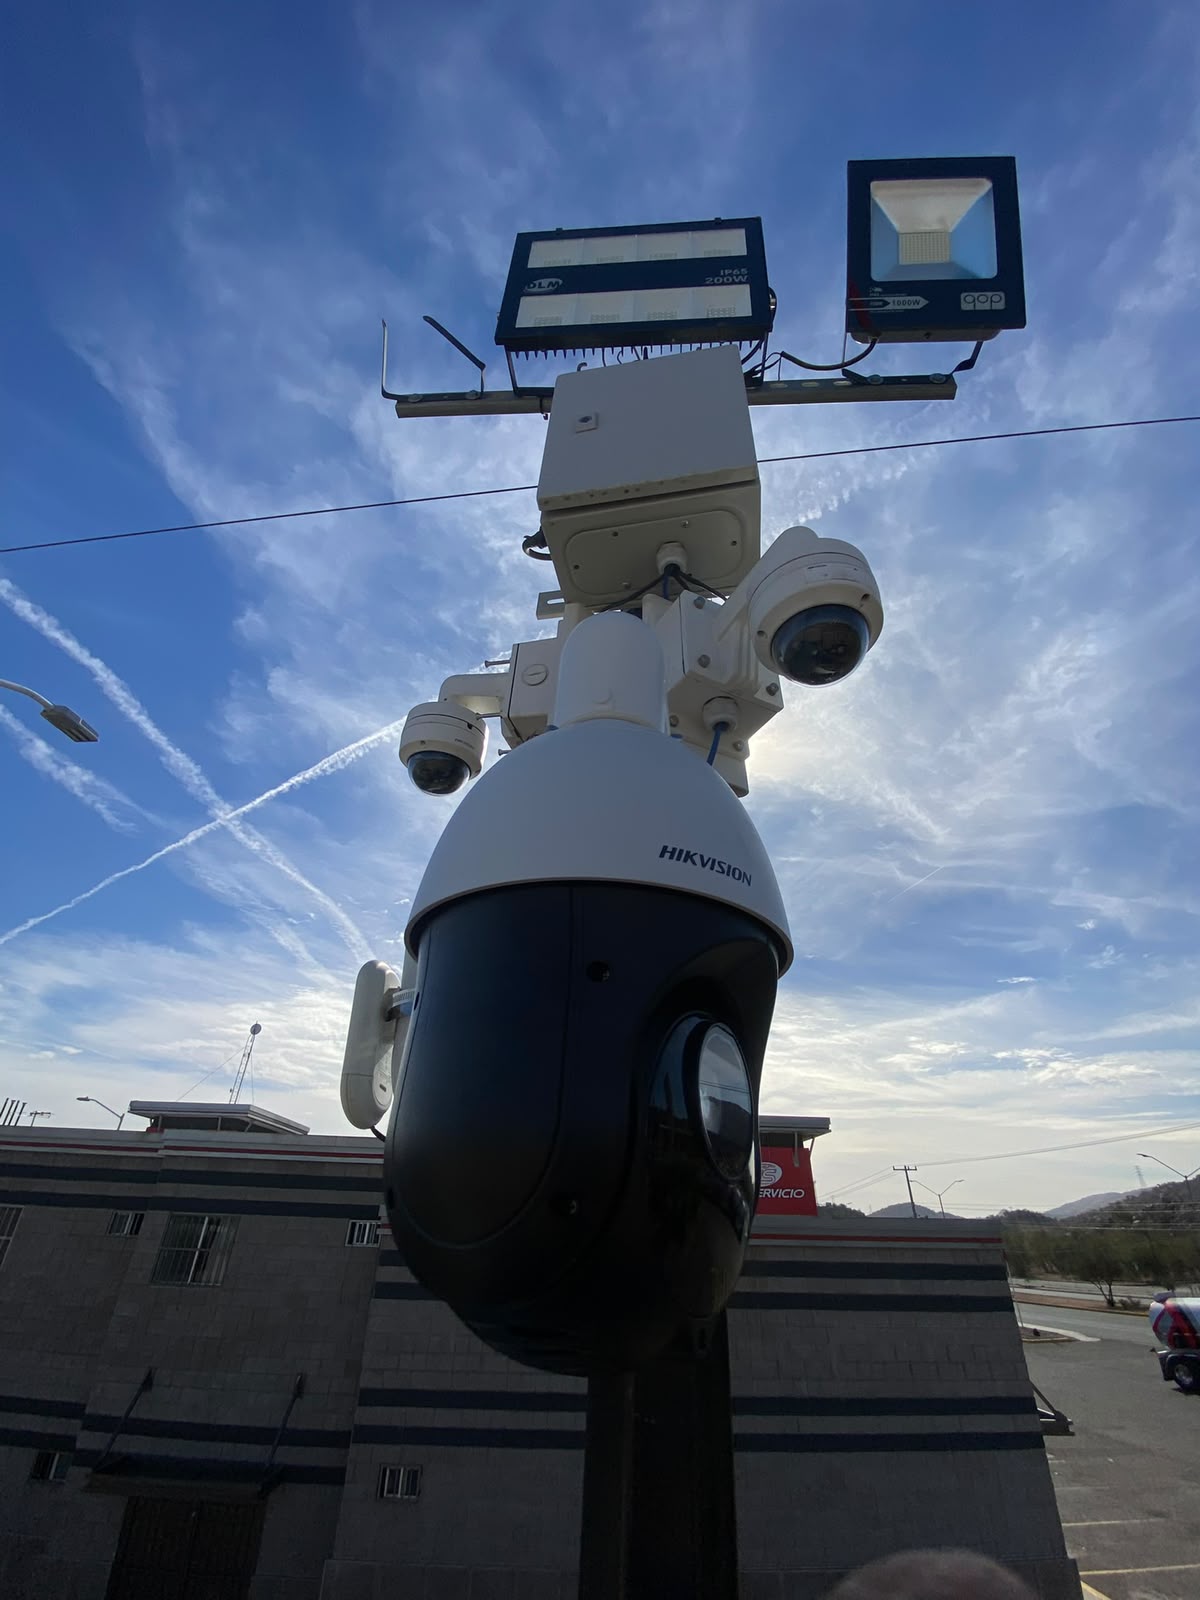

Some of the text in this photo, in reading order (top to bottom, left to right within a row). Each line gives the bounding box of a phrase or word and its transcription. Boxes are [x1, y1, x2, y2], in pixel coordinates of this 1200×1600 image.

[720, 268, 748, 276] IP65
[704, 275, 749, 285] 200W
[658, 845, 752, 887] HIKVISION
[759, 1188, 805, 1199] ERVICIO
